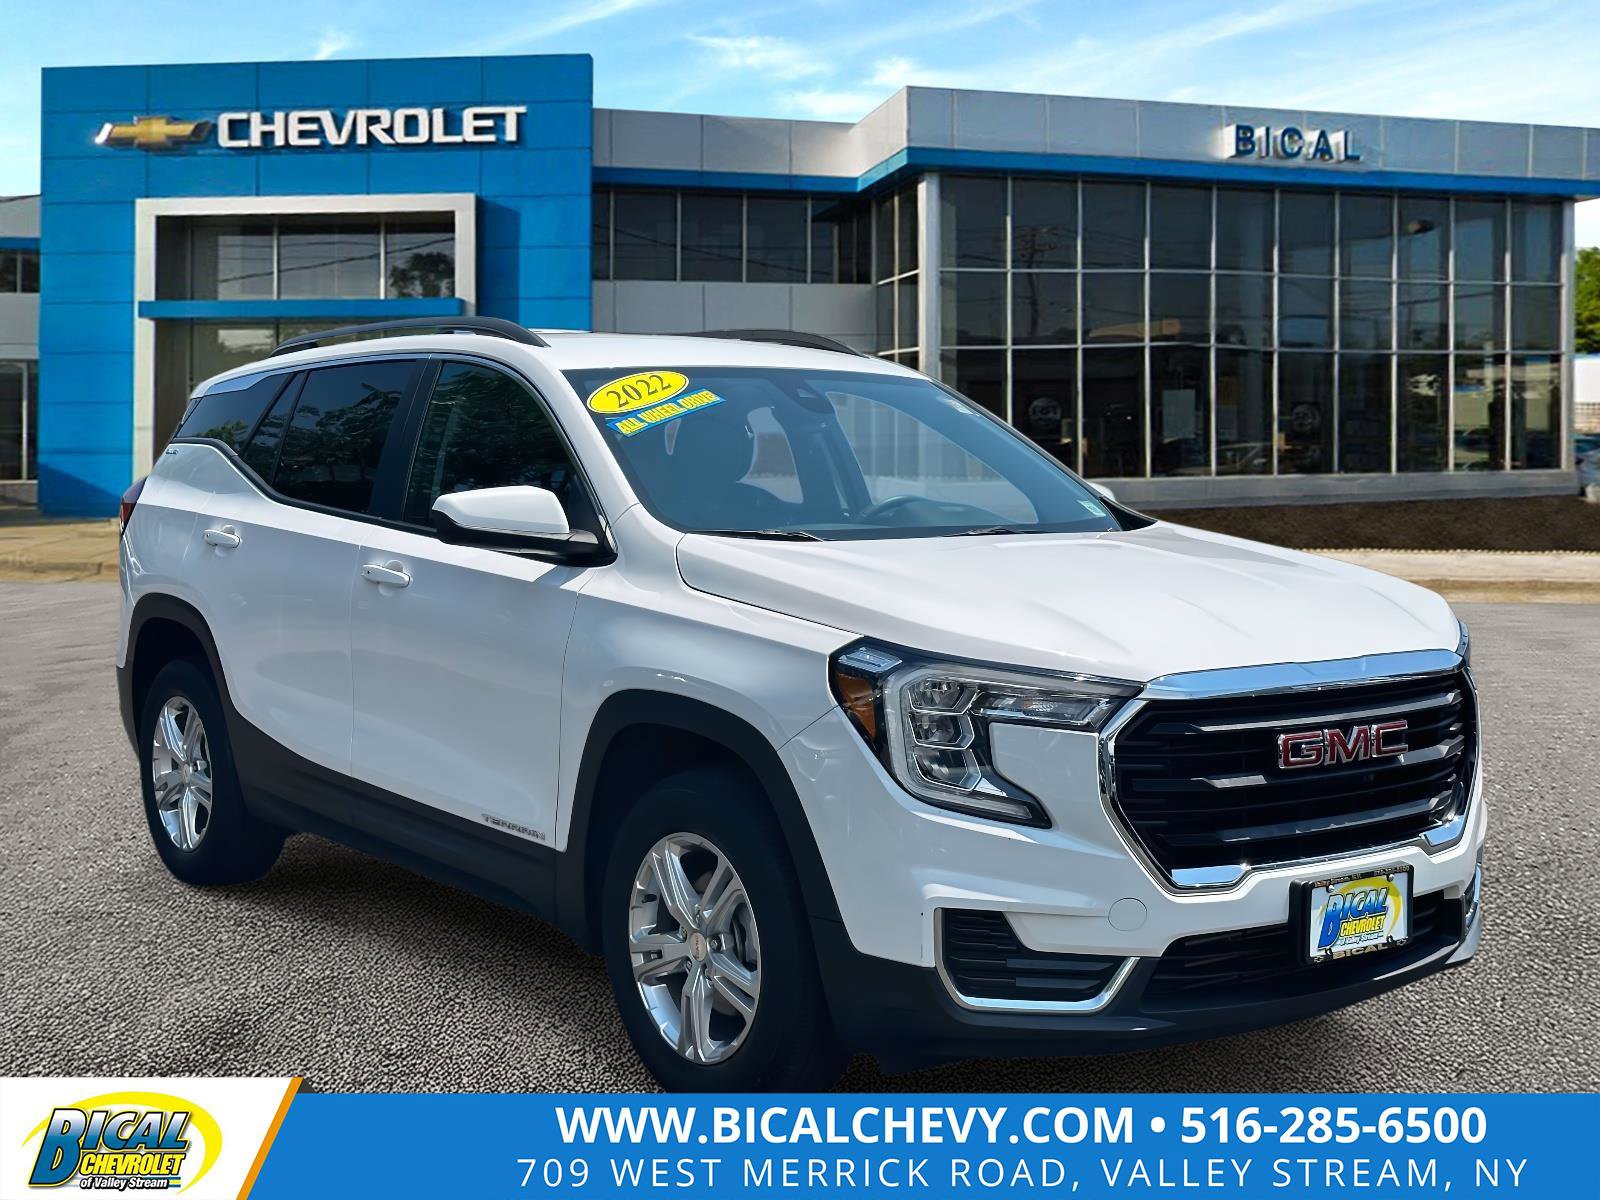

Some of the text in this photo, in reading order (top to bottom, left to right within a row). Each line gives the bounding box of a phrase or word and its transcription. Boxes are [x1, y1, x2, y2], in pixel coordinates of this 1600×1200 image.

[217, 106, 527, 149] CHEVROLET
[1231, 123, 1361, 162] BICAL
[606, 374, 672, 409] 2022
[615, 390, 720, 435] ALL WHEEL DRIVE
[1278, 719, 1409, 769] GMC
[481, 813, 546, 841] TERRAIN
[1318, 886, 1389, 949] BICAL
[1340, 914, 1387, 938] CHEVROLET
[1333, 942, 1388, 960] BICAL
